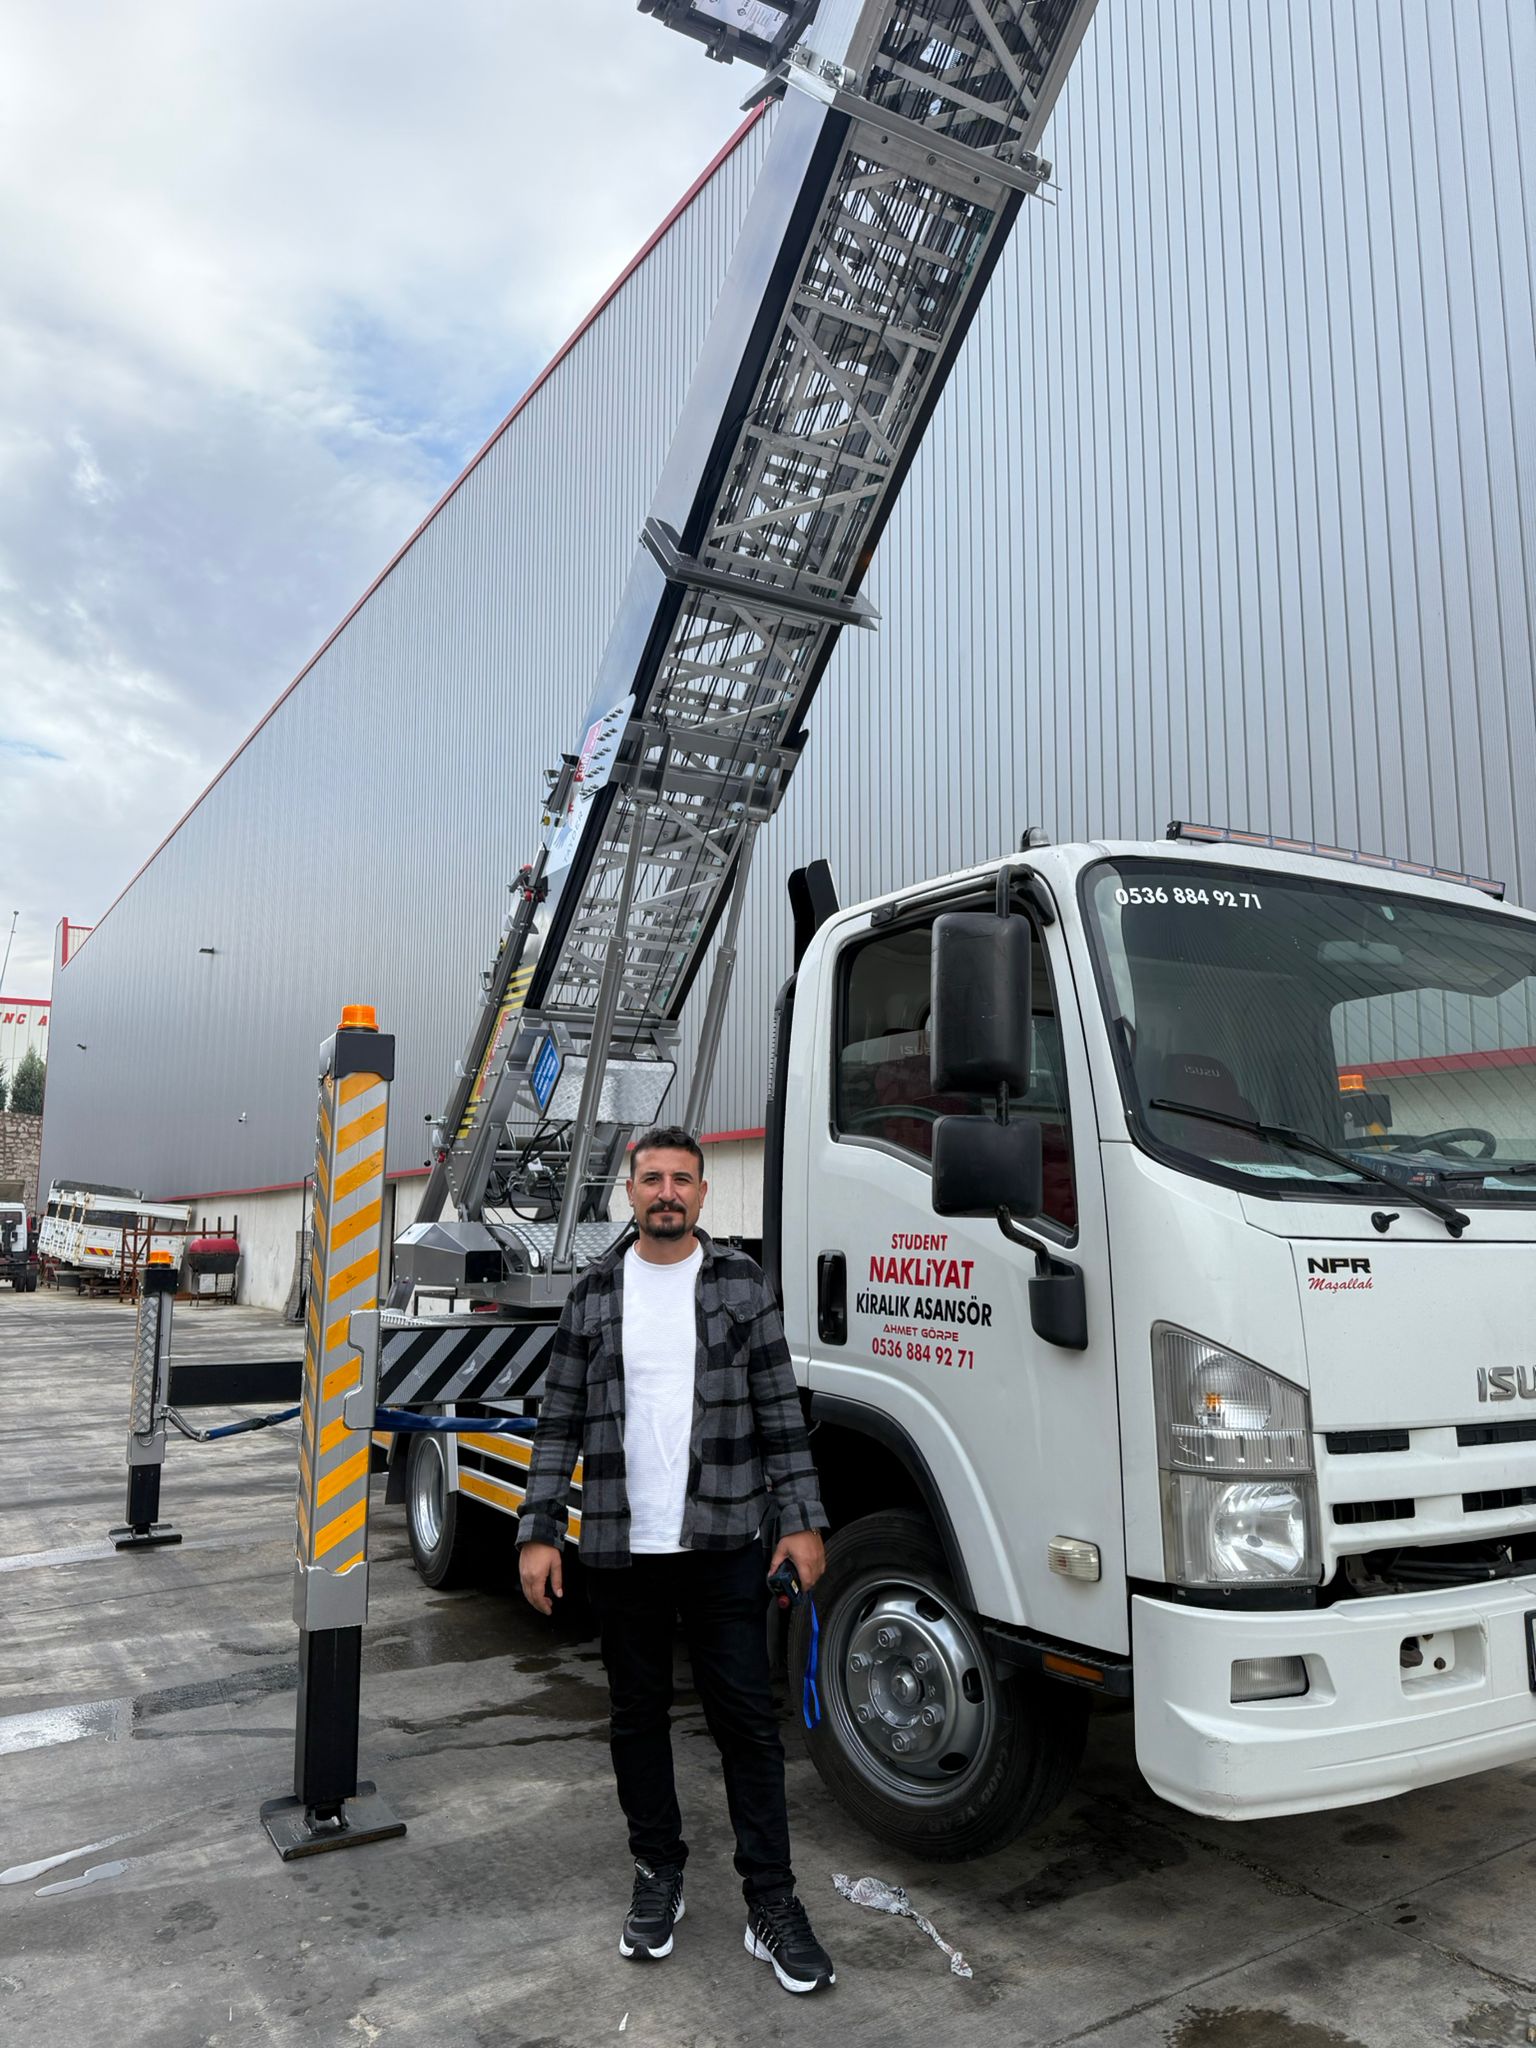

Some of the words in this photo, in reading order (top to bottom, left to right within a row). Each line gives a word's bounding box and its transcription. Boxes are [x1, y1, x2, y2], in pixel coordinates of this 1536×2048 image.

[1115, 887, 1169, 905] 0536
[1173, 888, 1209, 905] 884
[1213, 890, 1238, 907] 92
[1240, 893, 1262, 909] 71
[891, 1233, 948, 1251] STUDENT
[1308, 1258, 1371, 1274] NPR
[1308, 1277, 1373, 1294] Maşallah
[856, 1287, 910, 1318] KİRALIK
[913, 1295, 992, 1327] ASANSÖR
[883, 1324, 918, 1337] AHMET
[921, 1327, 959, 1342] GÖRPE
[872, 1337, 902, 1359] 0536
[906, 1342, 931, 1363] 884
[935, 1347, 953, 1367] 92
[957, 1350, 974, 1370] 71
[1477, 1365, 1536, 1402] ISU
